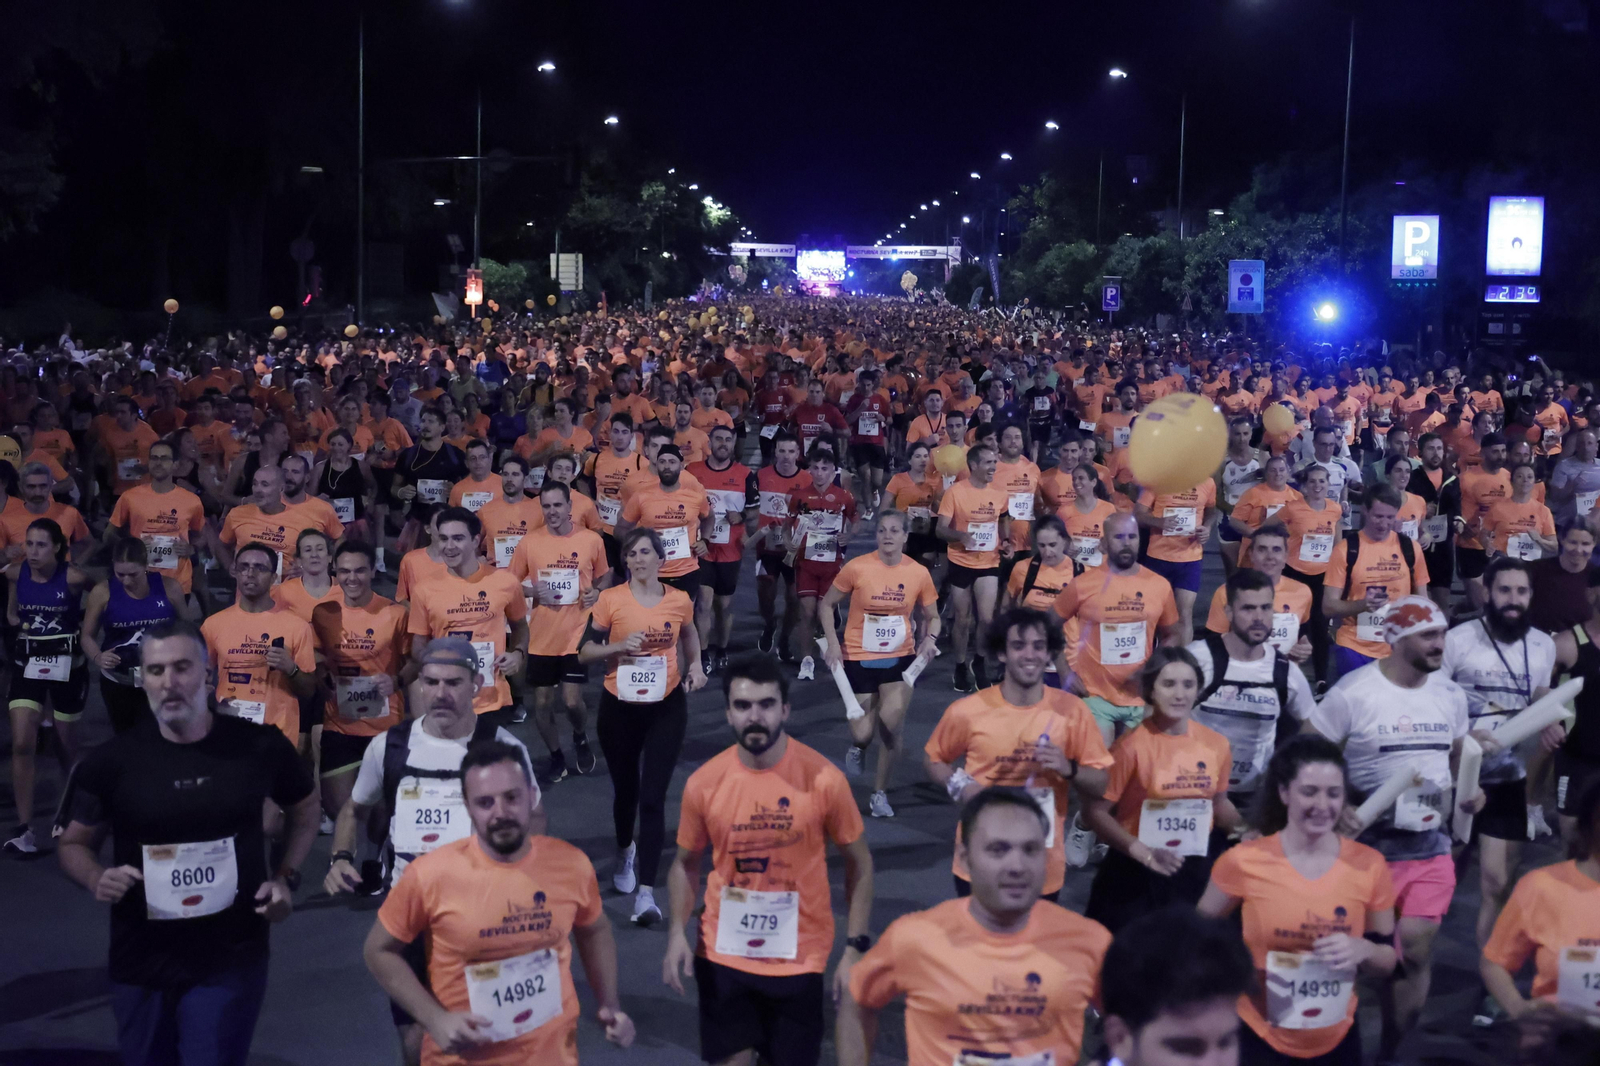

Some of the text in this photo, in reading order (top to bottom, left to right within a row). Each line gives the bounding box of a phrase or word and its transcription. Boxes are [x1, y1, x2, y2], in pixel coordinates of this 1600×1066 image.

[1405, 221, 1430, 256] P
[1399, 268, 1425, 277] saba
[1107, 287, 1116, 299] P
[975, 532, 993, 540] 10021
[1310, 543, 1327, 551] 9812
[547, 581, 572, 591] 16443
[875, 628, 896, 638] 5919
[1114, 636, 1136, 648] 3550
[631, 672, 656, 683] 6282
[347, 690, 377, 702] 20647
[1378, 725, 1389, 734] EL
[415, 808, 450, 825] 2831
[1156, 816, 1197, 831] 13346
[171, 866, 215, 887] 8600
[502, 911, 552, 924] NOCTURNA
[740, 913, 778, 930] 4779
[479, 924, 526, 938] SEVILLA
[492, 974, 546, 1007] 14982
[1289, 980, 1341, 998] 14930
